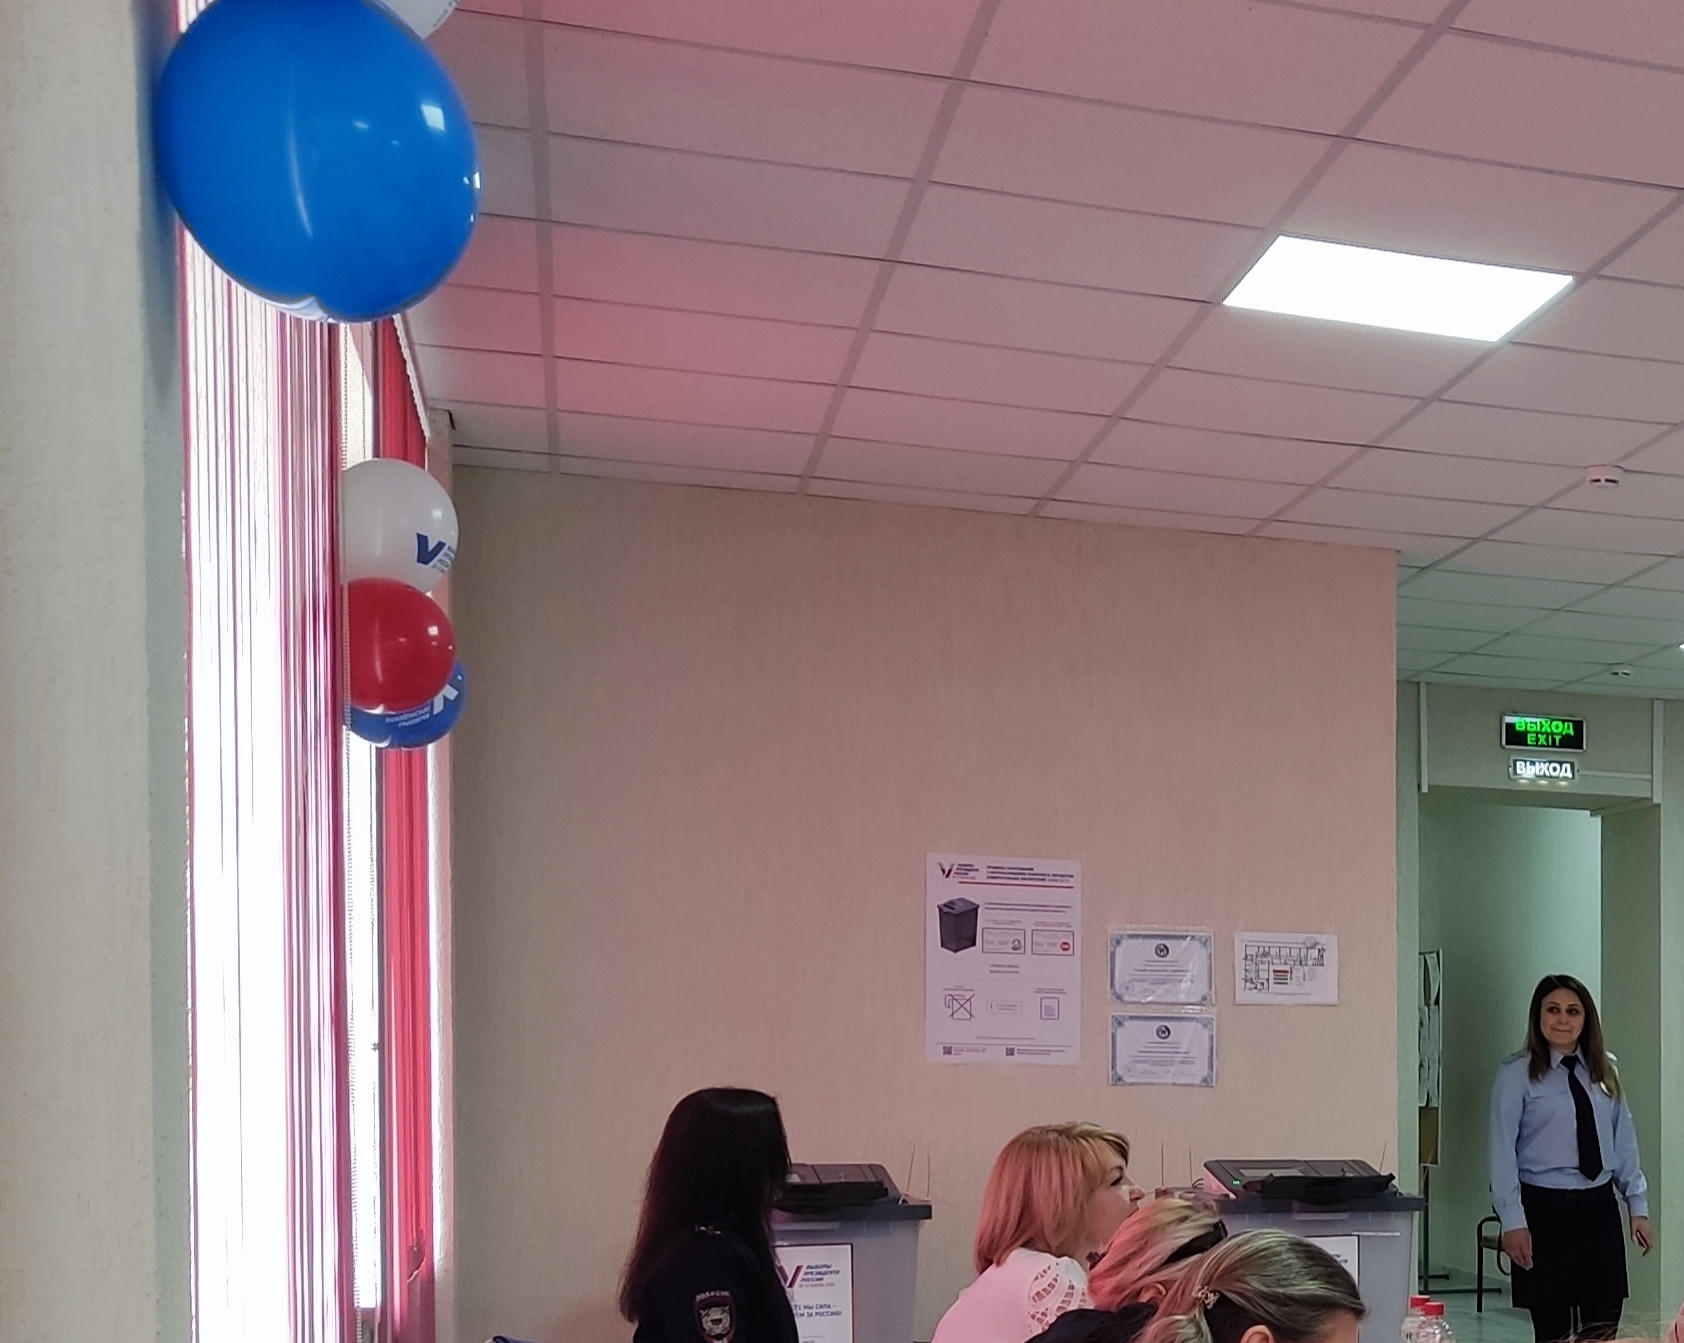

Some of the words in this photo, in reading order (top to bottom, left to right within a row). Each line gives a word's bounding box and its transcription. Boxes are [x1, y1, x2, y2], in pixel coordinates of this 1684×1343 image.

[1515, 719, 1574, 736] ВЫХОД
[1527, 734, 1562, 746] EXIT
[1516, 761, 1572, 779] ВЫХОД
